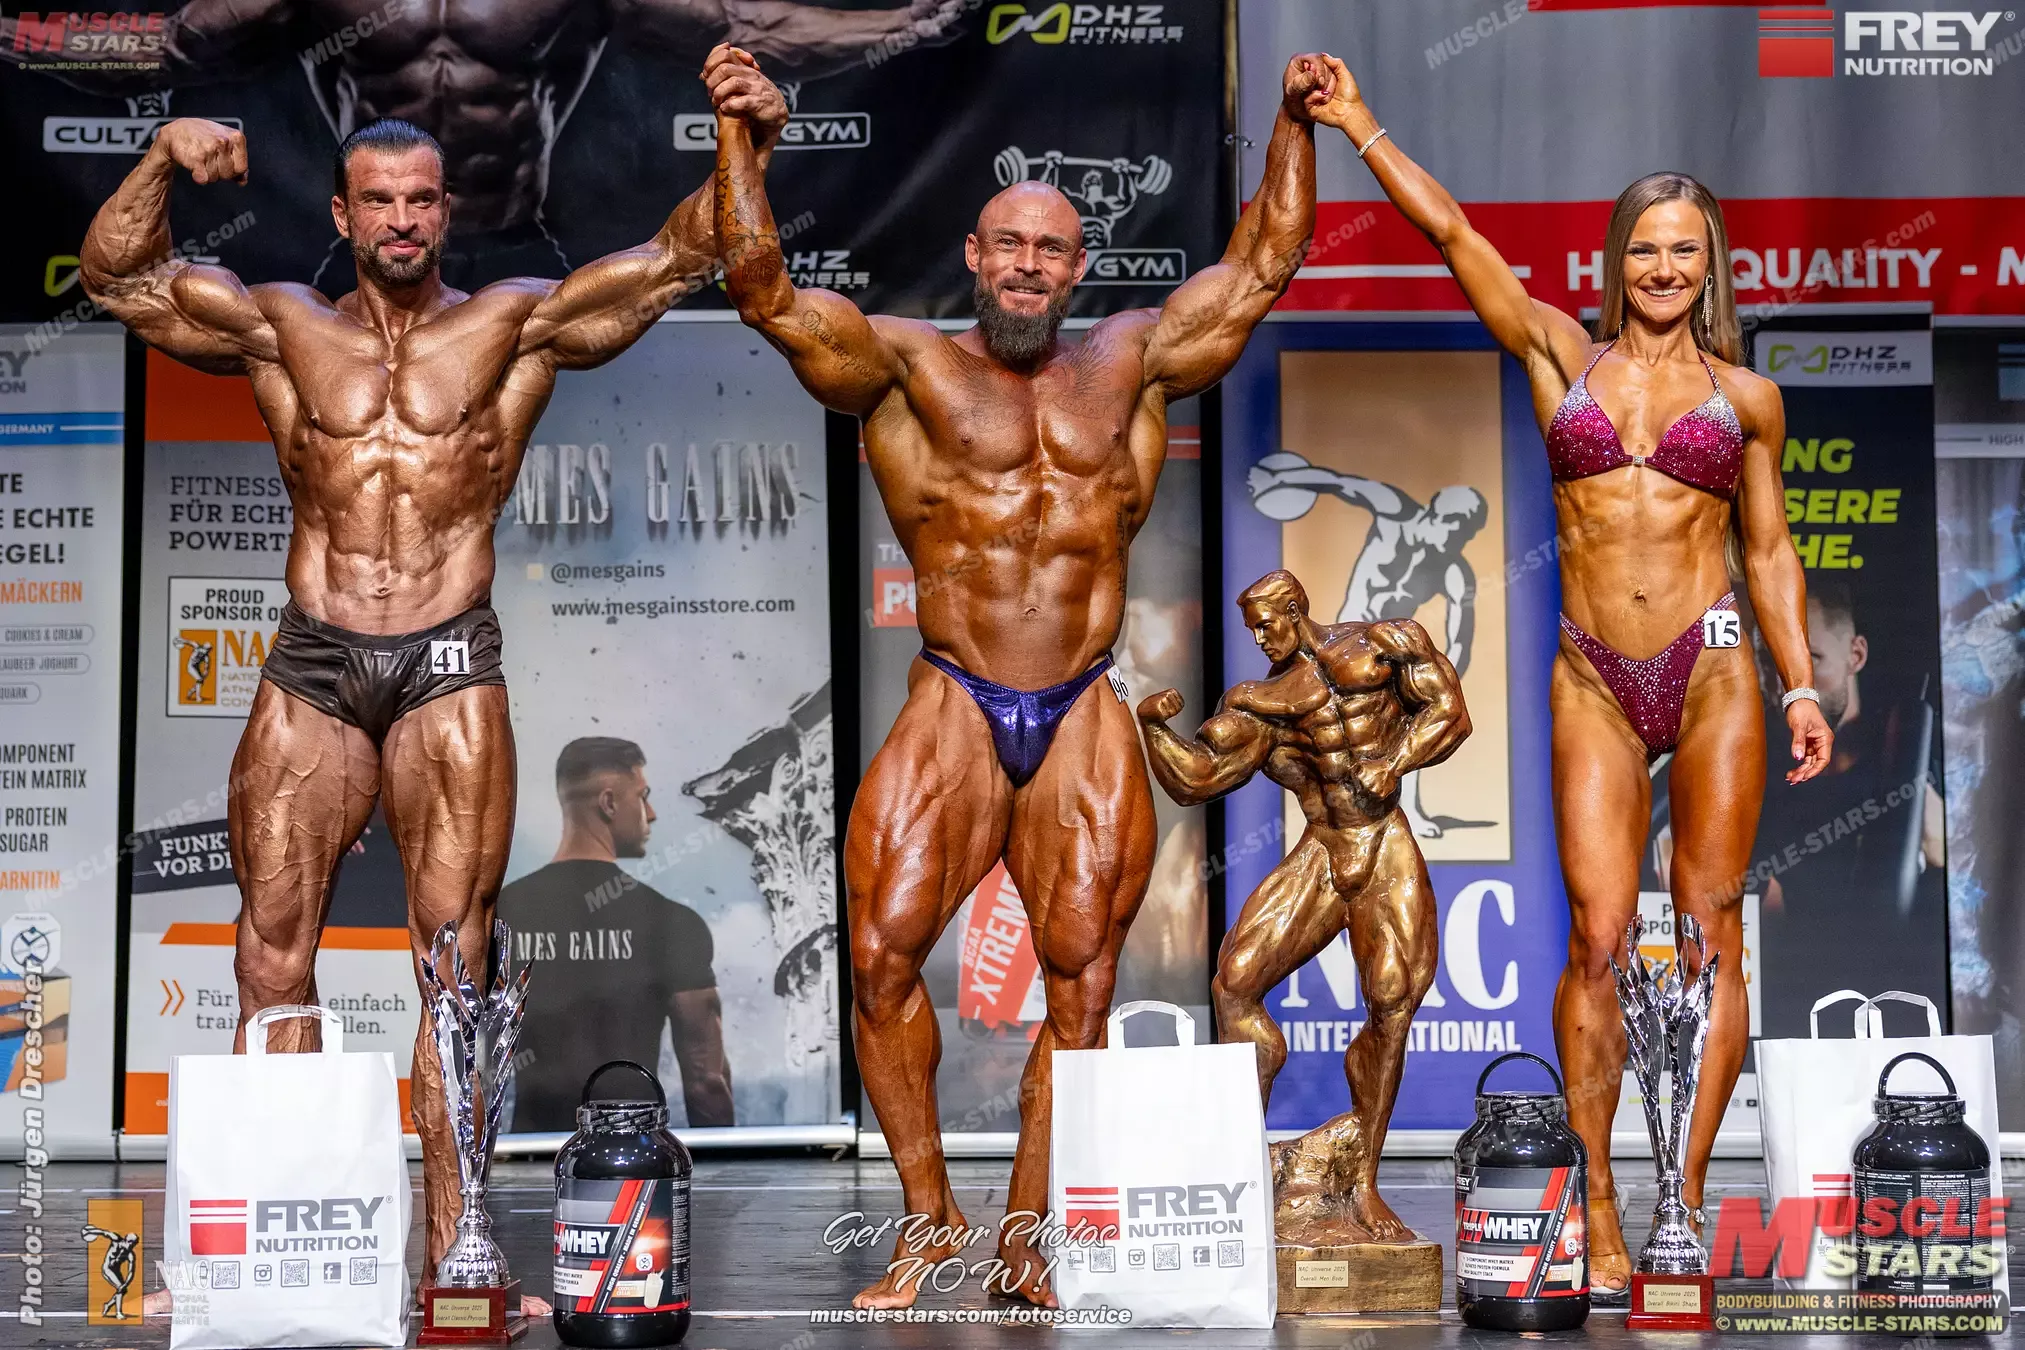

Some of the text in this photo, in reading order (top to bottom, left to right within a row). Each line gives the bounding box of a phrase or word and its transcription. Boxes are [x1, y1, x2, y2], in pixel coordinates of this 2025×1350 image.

[1072, 5, 1164, 25] DHZ
[1069, 26, 1184, 40] FITNESS
[1844, 57, 1994, 76] NUTRITION
[54, 126, 146, 145] CULT
[780, 120, 861, 142] GYM
[783, 250, 851, 271] HZ
[1094, 255, 1176, 277] GYM
[1730, 247, 1943, 291] QUALITY
[1831, 346, 1898, 360] DHZ
[170, 476, 281, 497] FITNESS
[514, 440, 801, 525] MES GAINS
[13, 507, 94, 528] ECHTE
[169, 498, 223, 522] FÜR
[169, 531, 291, 551] POWERT
[551, 560, 665, 583] @mesgains
[205, 588, 265, 604] PROUD
[552, 595, 795, 619] www.mesgainsstore.com
[181, 605, 263, 621] SPONSOR
[1706, 620, 1739, 646] 15
[222, 630, 278, 668] NA
[434, 646, 468, 673] 41
[32, 769, 87, 788] MATRIX
[5, 807, 68, 826] PROTEIN
[153, 856, 204, 878] VOR
[515, 929, 633, 961] MES GAINS
[196, 989, 407, 1012] Für einfach
[1282, 1020, 1522, 1053] INTETIONAL
[1128, 1219, 1243, 1239] NUTRITION
[1483, 1217, 1543, 1241] WHEY
[255, 1235, 378, 1254] NUTRITION
[562, 1230, 611, 1255] WHEY
